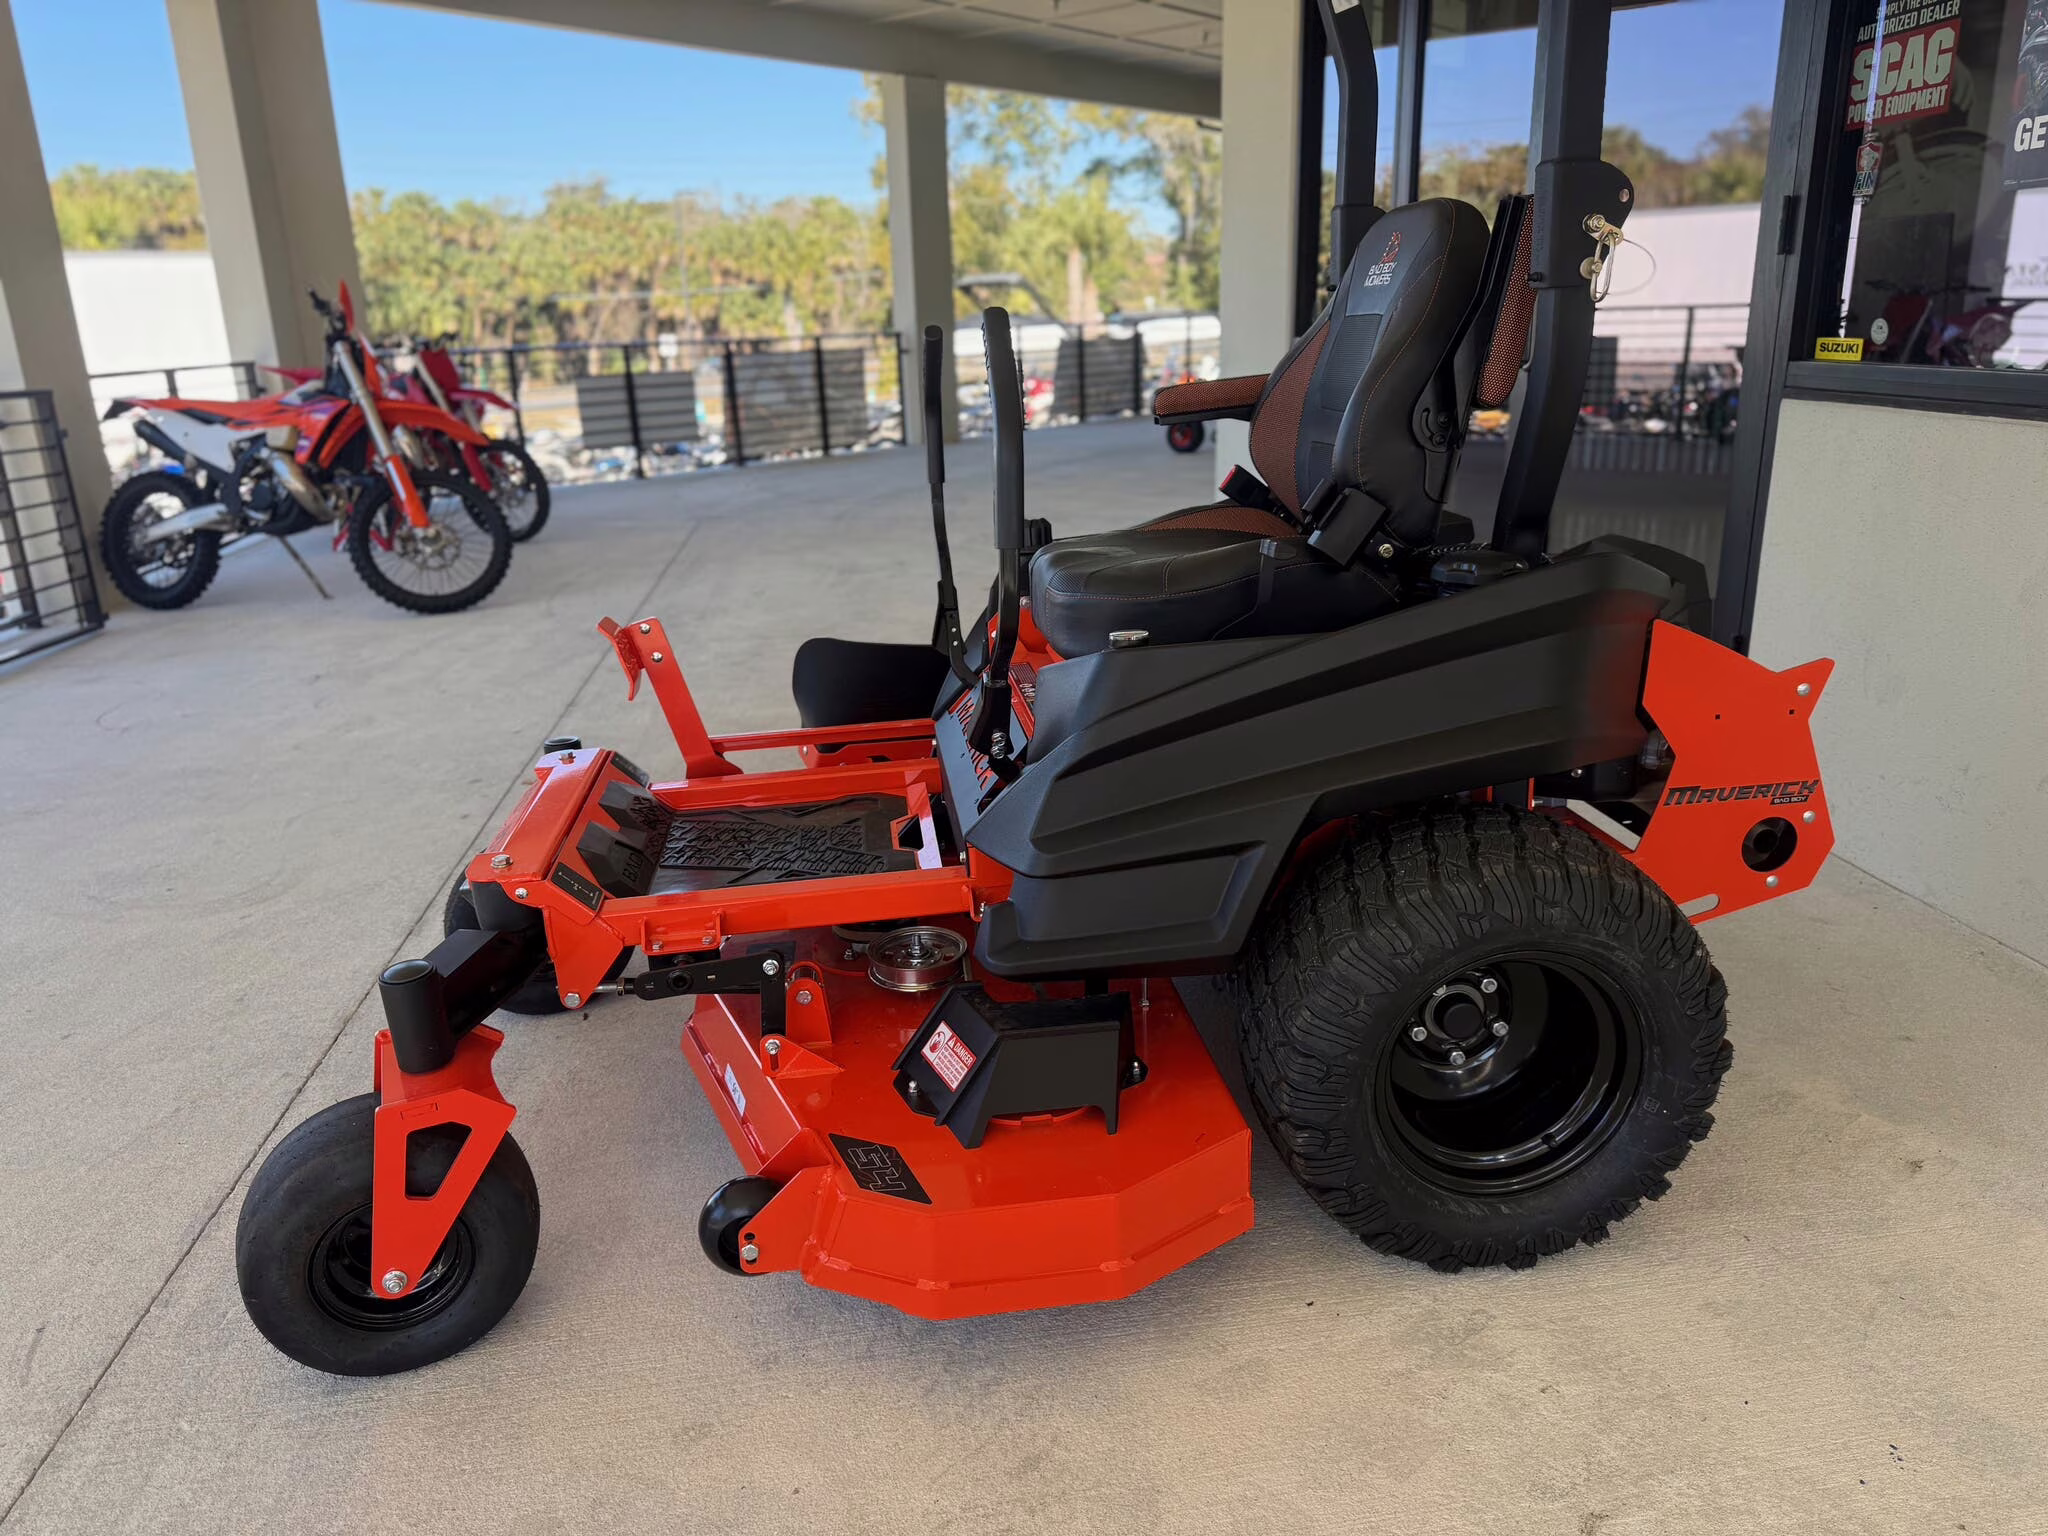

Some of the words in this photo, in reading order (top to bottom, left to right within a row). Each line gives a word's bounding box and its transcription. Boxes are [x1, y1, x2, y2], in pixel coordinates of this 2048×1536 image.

[1857, 12, 1919, 42] AUTORIZED
[1919, 0, 1961, 25] DEALER
[1850, 27, 1956, 102] SCAG
[1884, 84, 1948, 117] EQUIPMENT
[1819, 342, 1860, 354] SUZUKI
[1663, 779, 1820, 806] MAVERICK
[953, 1042, 974, 1067] DANGER
[848, 1144, 907, 1192] 54
